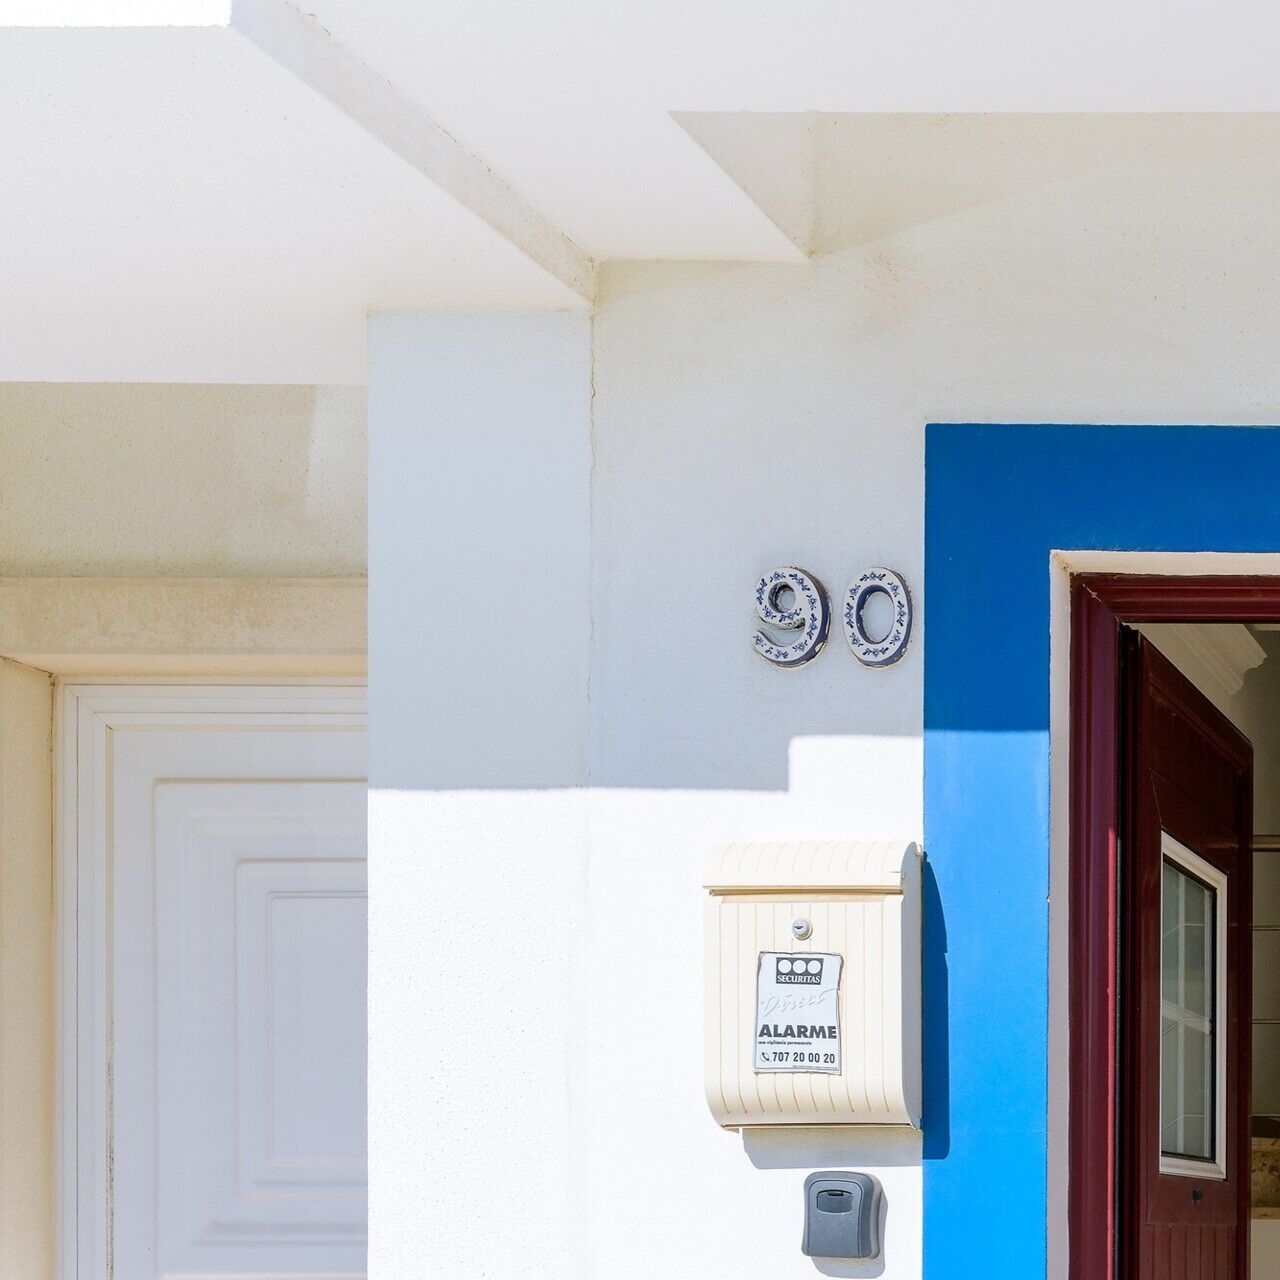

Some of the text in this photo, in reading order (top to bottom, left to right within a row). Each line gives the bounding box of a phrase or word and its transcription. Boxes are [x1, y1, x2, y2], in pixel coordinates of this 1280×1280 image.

[751, 566, 914, 670] 90
[777, 974, 821, 984] SECURITAS
[758, 1024, 838, 1039] ALARME
[772, 1051, 835, 1064] 707 20 00 20
